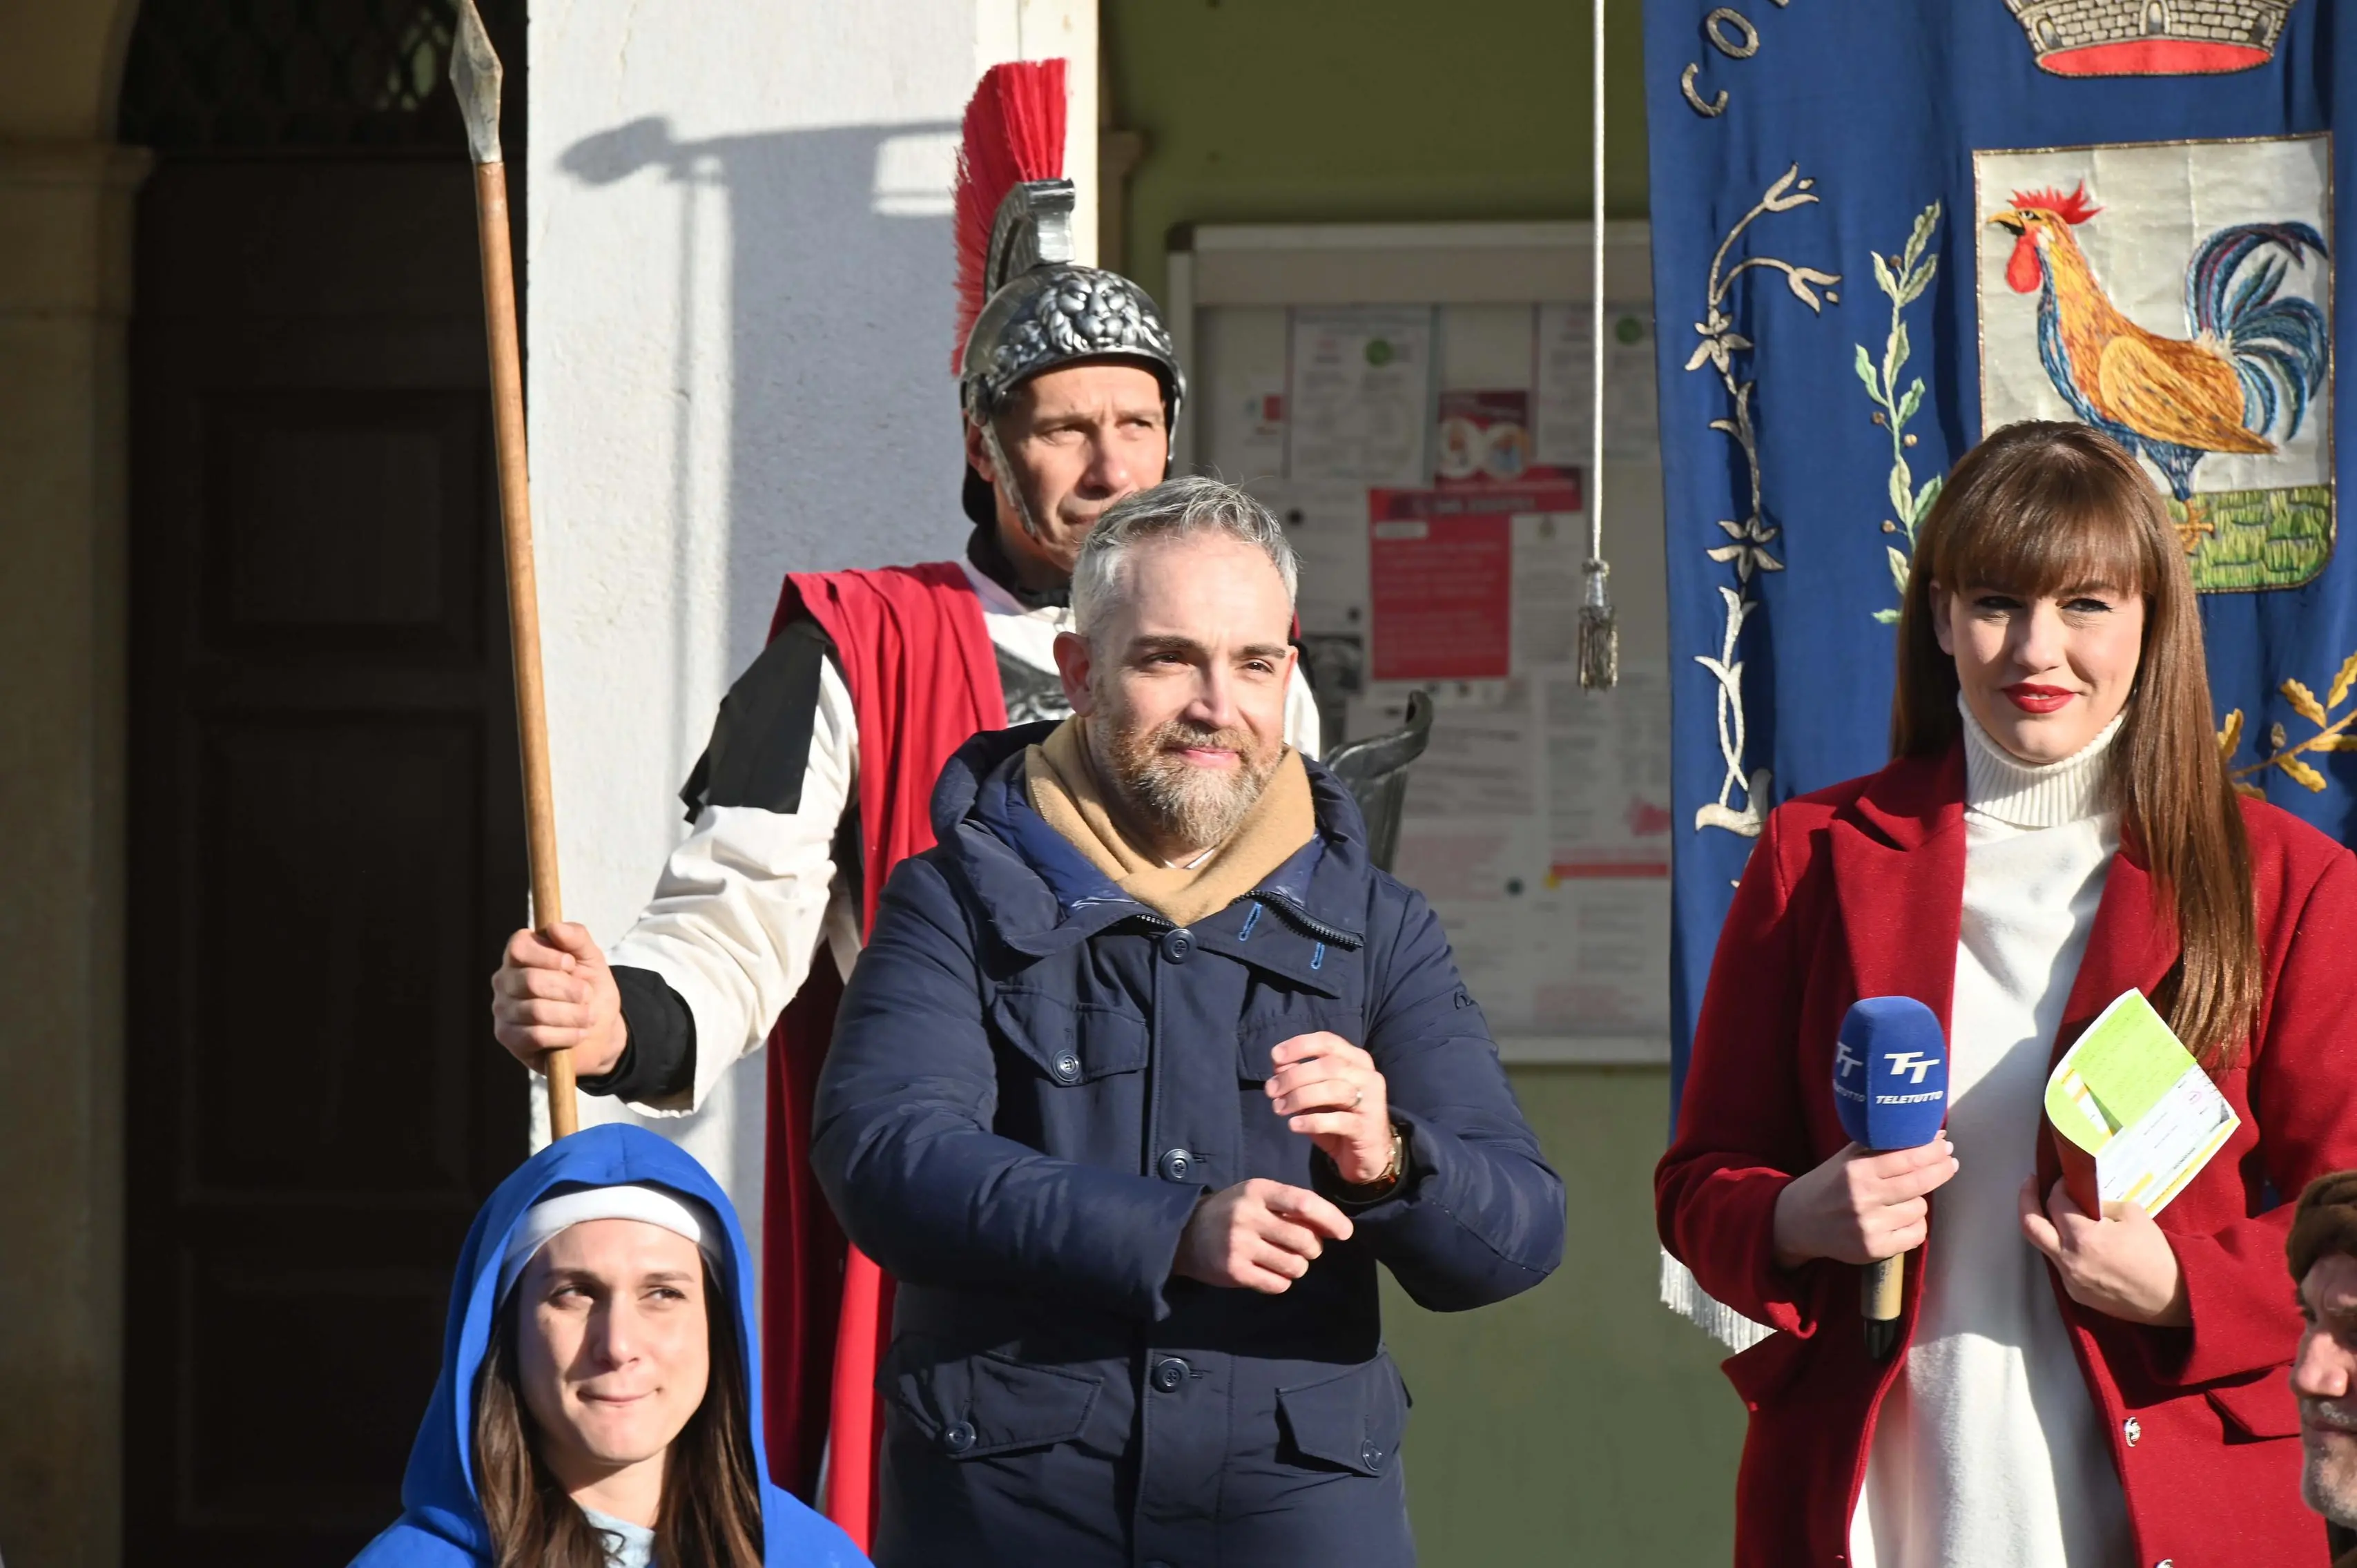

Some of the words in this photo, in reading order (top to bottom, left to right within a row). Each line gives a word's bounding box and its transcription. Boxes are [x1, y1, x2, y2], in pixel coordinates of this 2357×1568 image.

[1681, 0, 1790, 117] CO
[1883, 1052, 1941, 1084] TT
[1876, 1090, 1943, 1104] TELETUTTO
